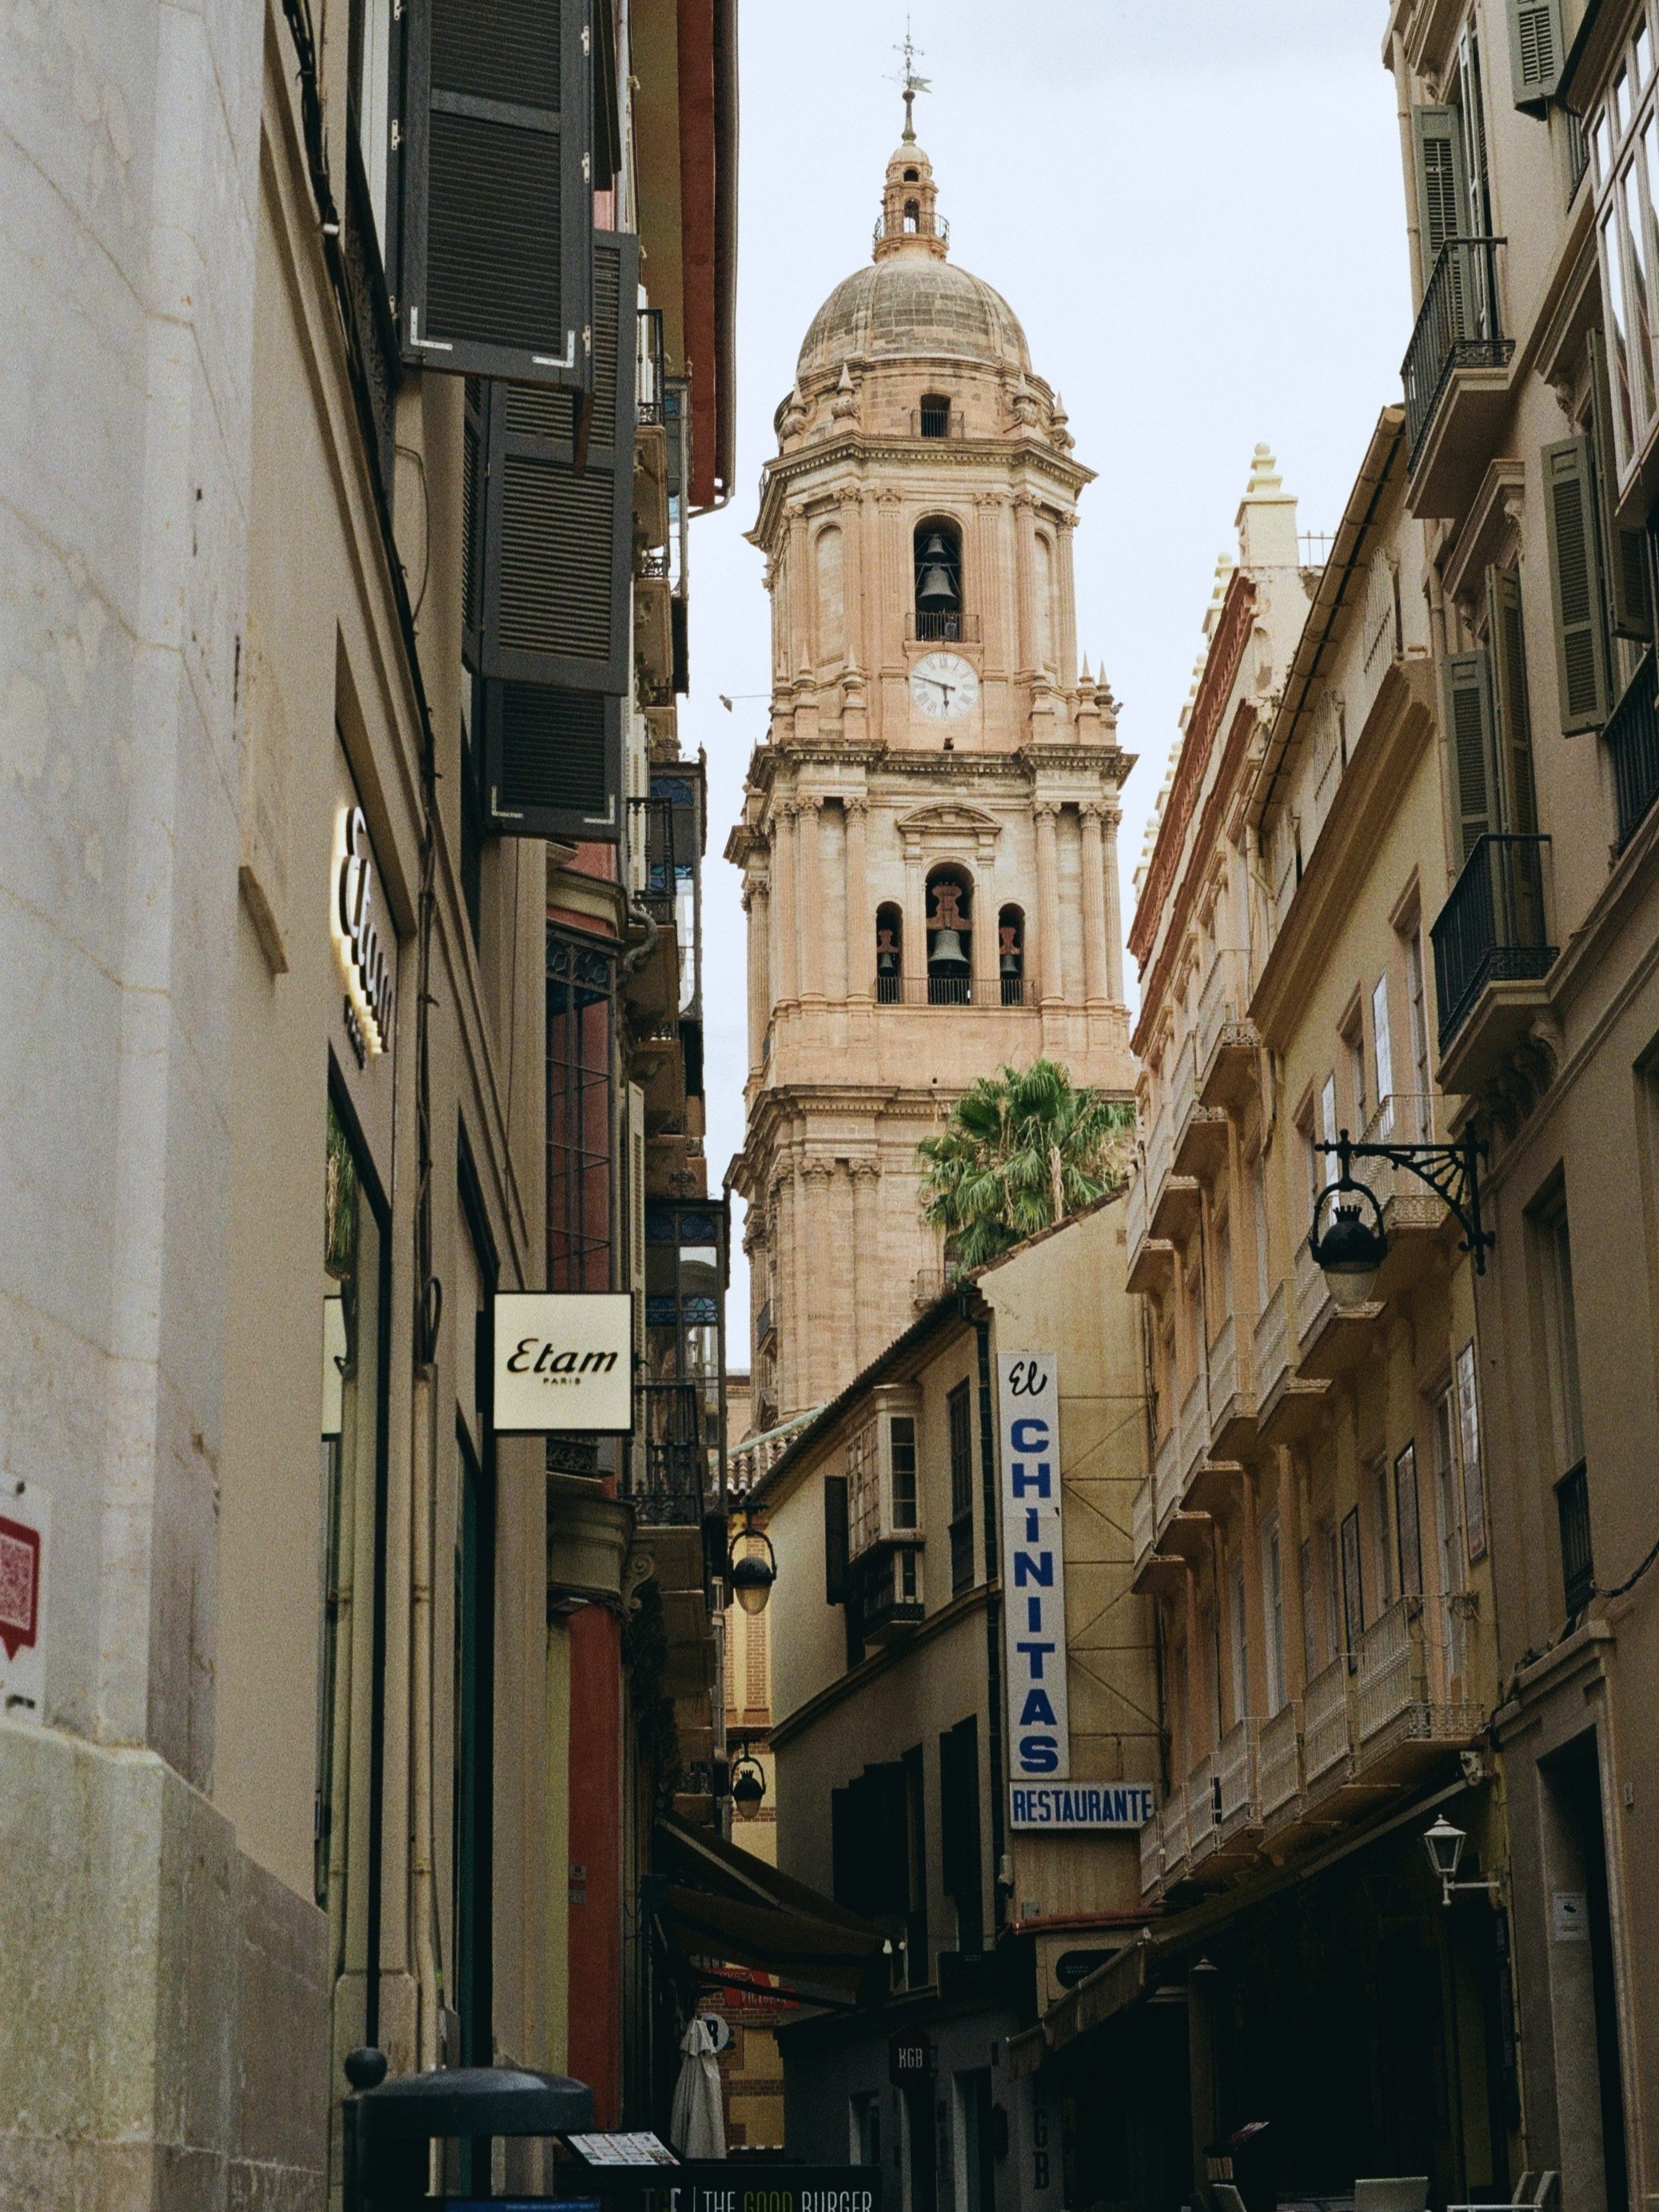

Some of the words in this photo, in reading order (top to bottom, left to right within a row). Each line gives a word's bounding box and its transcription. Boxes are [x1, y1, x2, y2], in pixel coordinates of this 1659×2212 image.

[506, 1337, 618, 1373] Etam
[1009, 1361, 1047, 1397] El
[1011, 1418, 1059, 1773] CHINITAS
[1013, 1789, 1152, 1823] RESTAURANTE
[898, 2047, 923, 2068] KGB
[702, 2190, 736, 2212] THE
